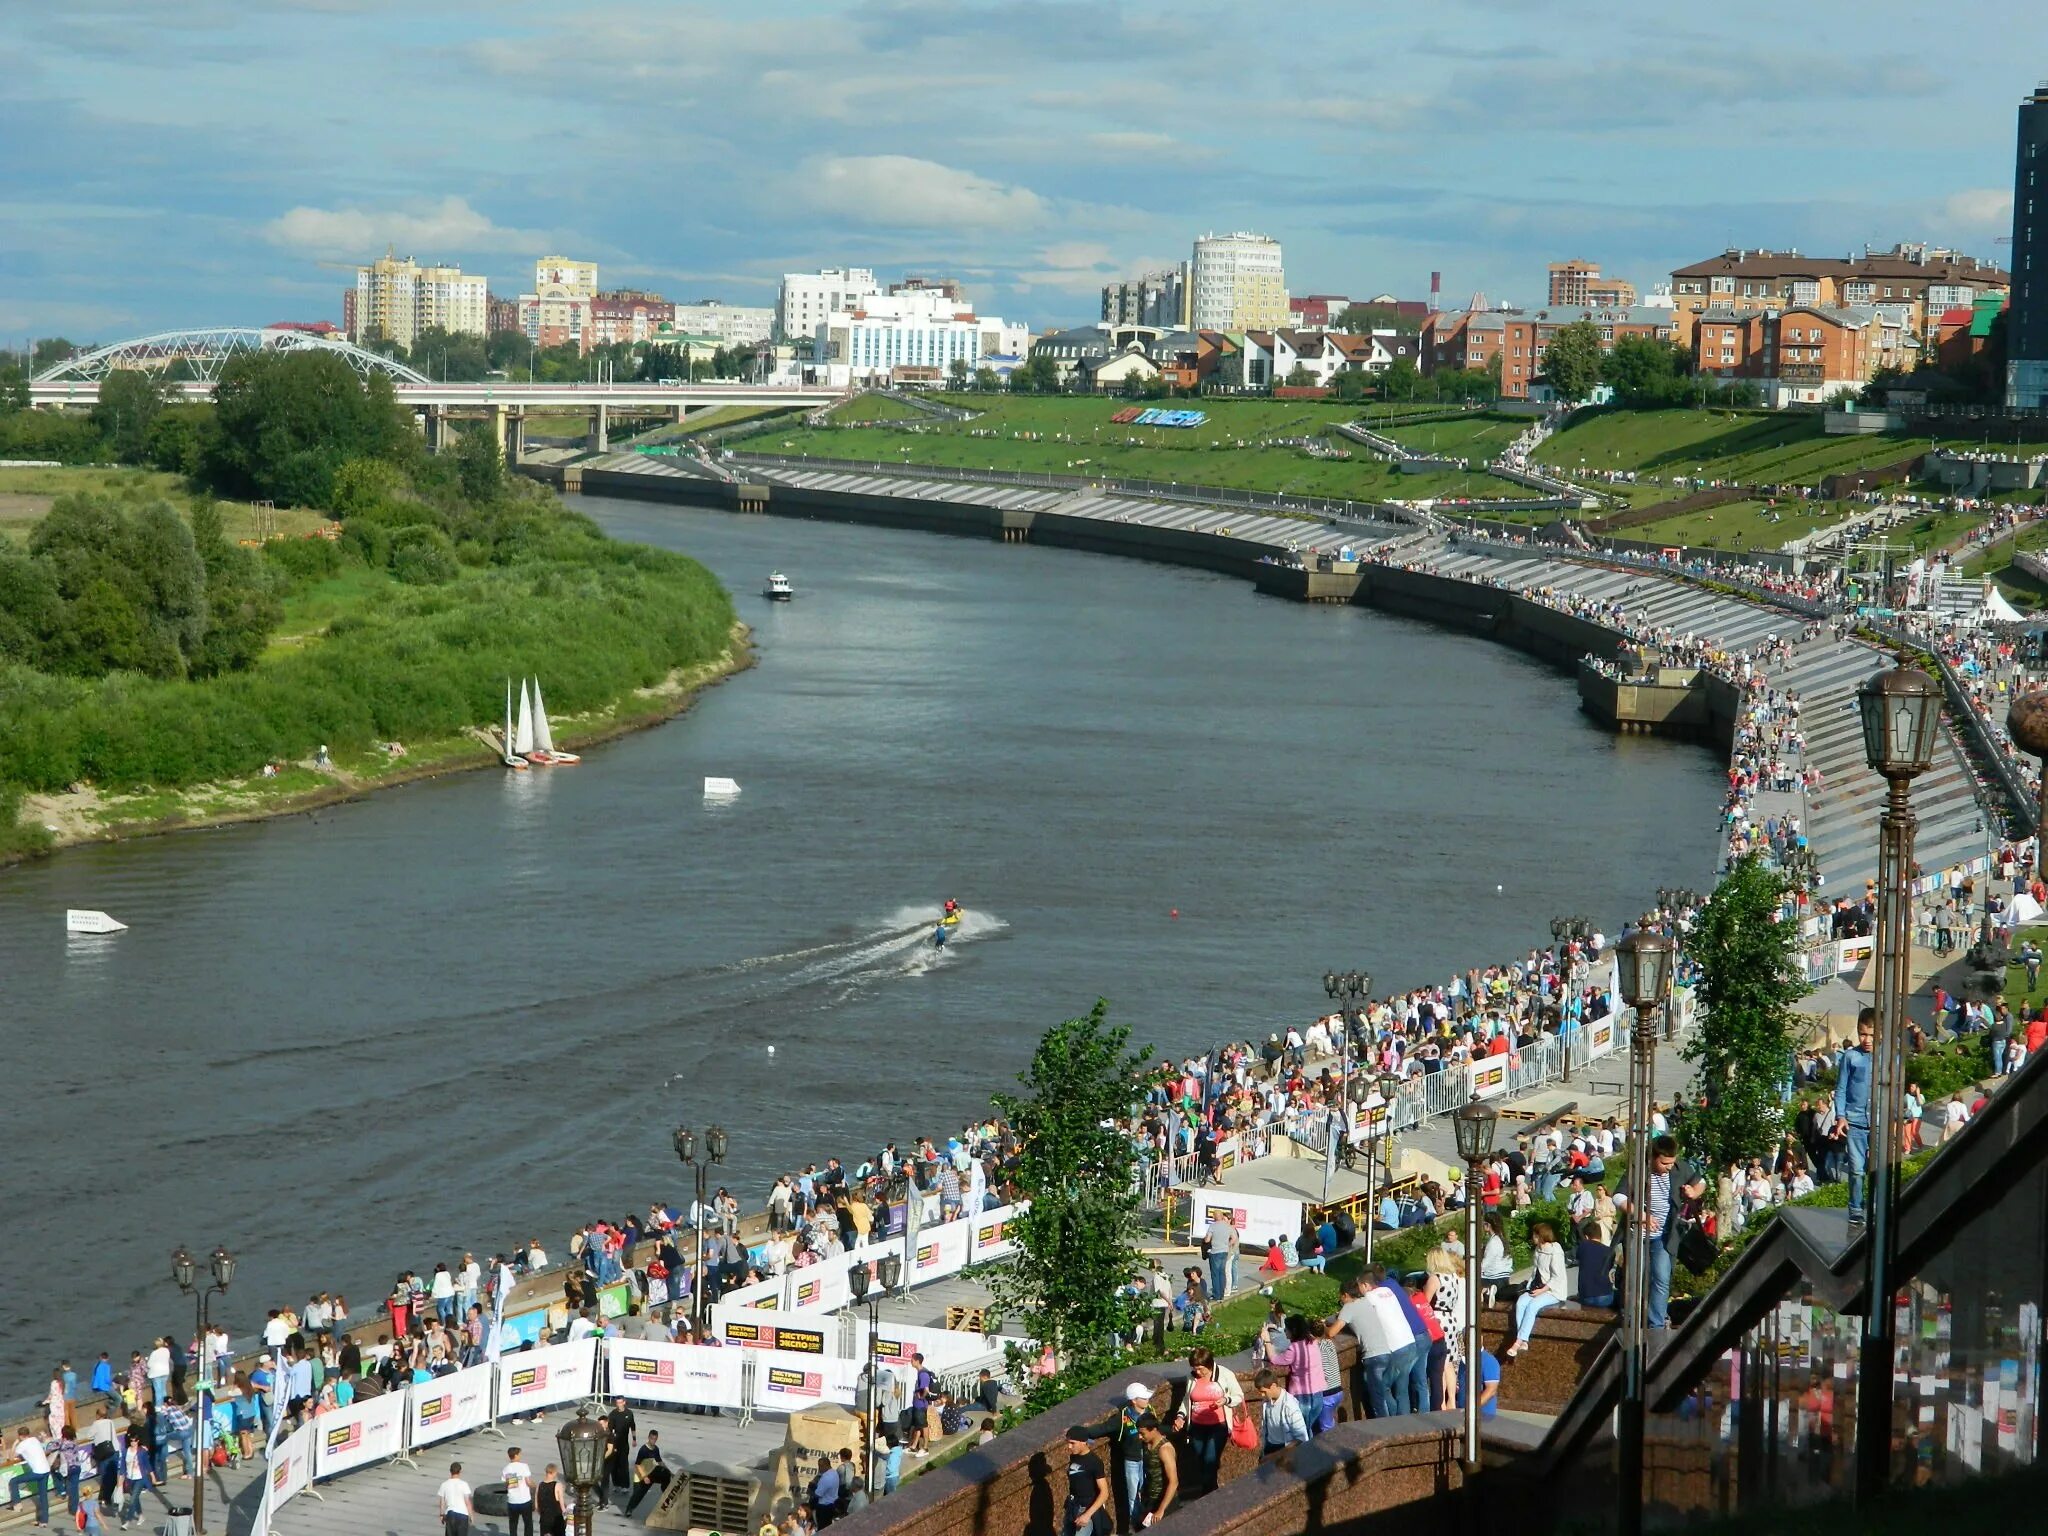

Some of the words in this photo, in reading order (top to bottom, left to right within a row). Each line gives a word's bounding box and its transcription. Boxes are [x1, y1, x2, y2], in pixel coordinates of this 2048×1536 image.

[779, 1332, 820, 1342] ЭКСТРИМ
[779, 1339, 808, 1349] ЭКСПО
[797, 1447, 840, 1460] КРЕПЫЖ
